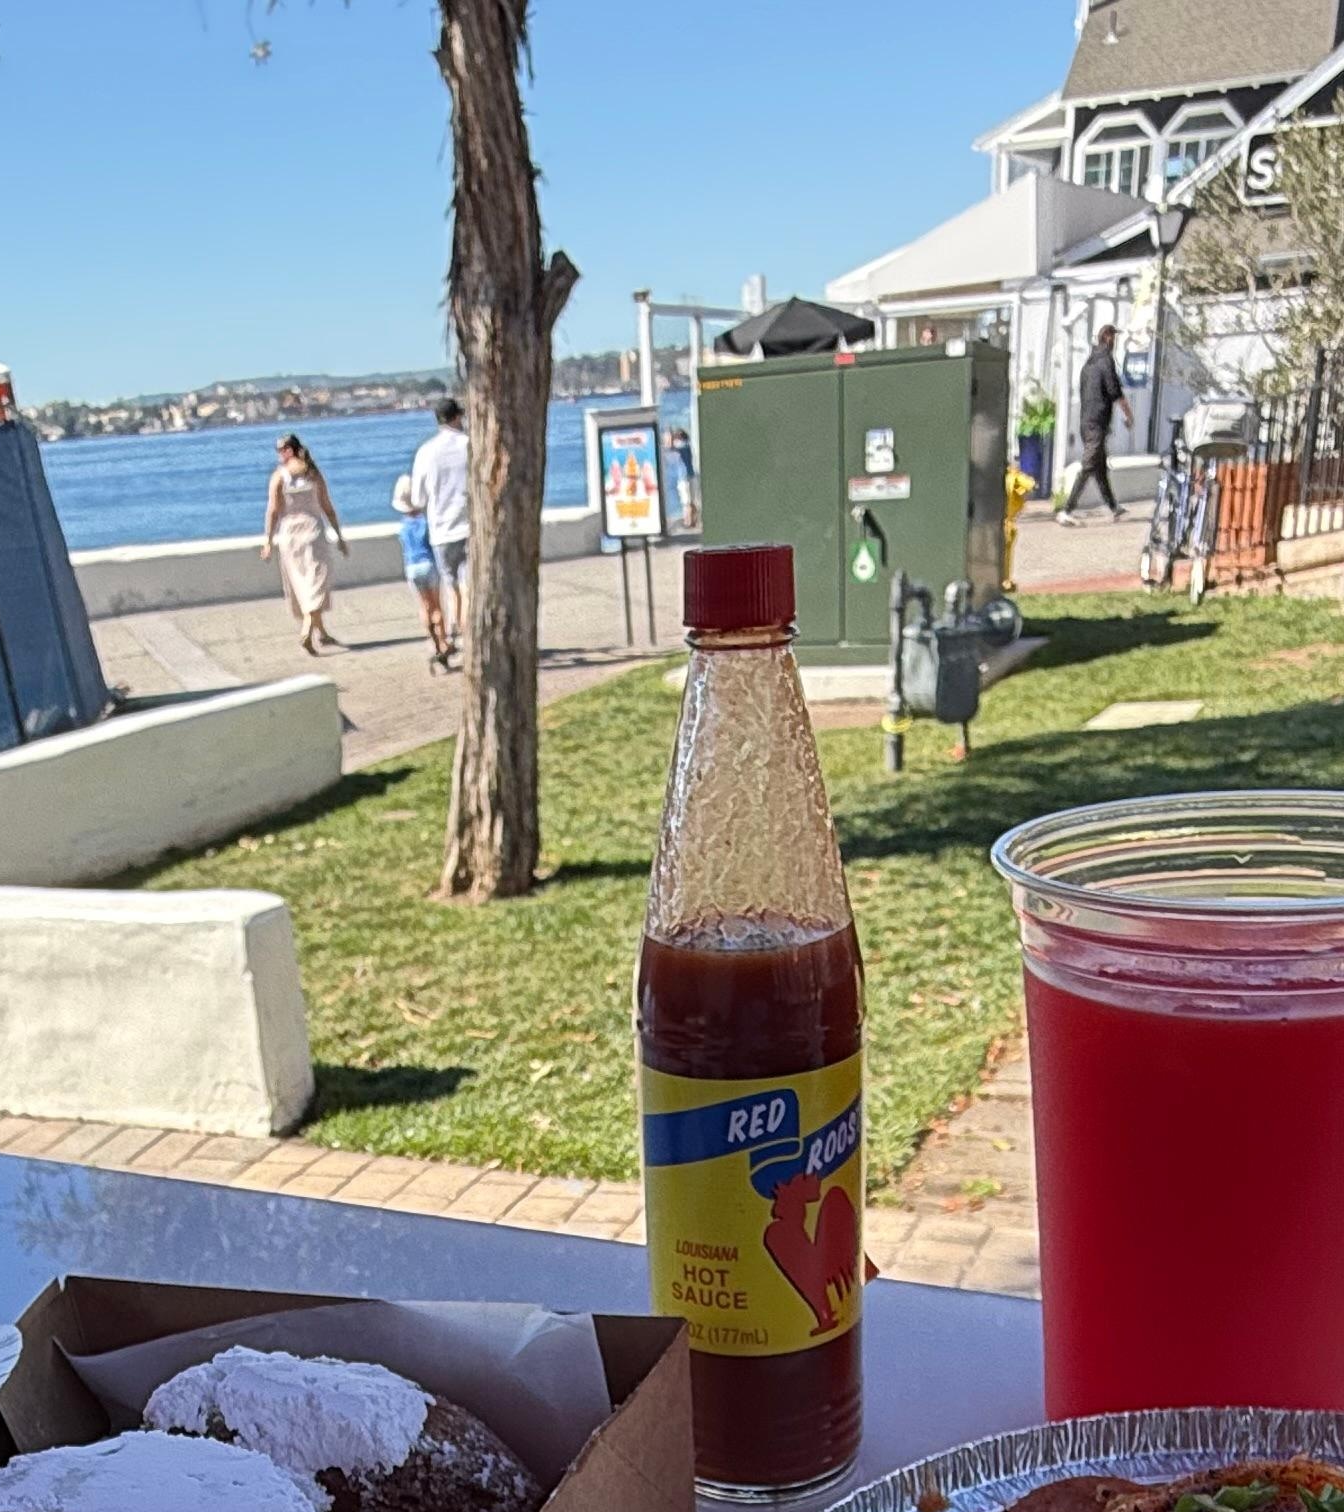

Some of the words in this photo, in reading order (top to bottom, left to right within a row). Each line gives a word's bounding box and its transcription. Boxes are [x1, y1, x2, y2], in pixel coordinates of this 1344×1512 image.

[727, 1097, 786, 1143] RED
[675, 1239, 739, 1262] LOUISIANA
[682, 1263, 731, 1288] HOT
[671, 1281, 749, 1310] SAUCE
[707, 1326, 769, 1347] (177mL)
